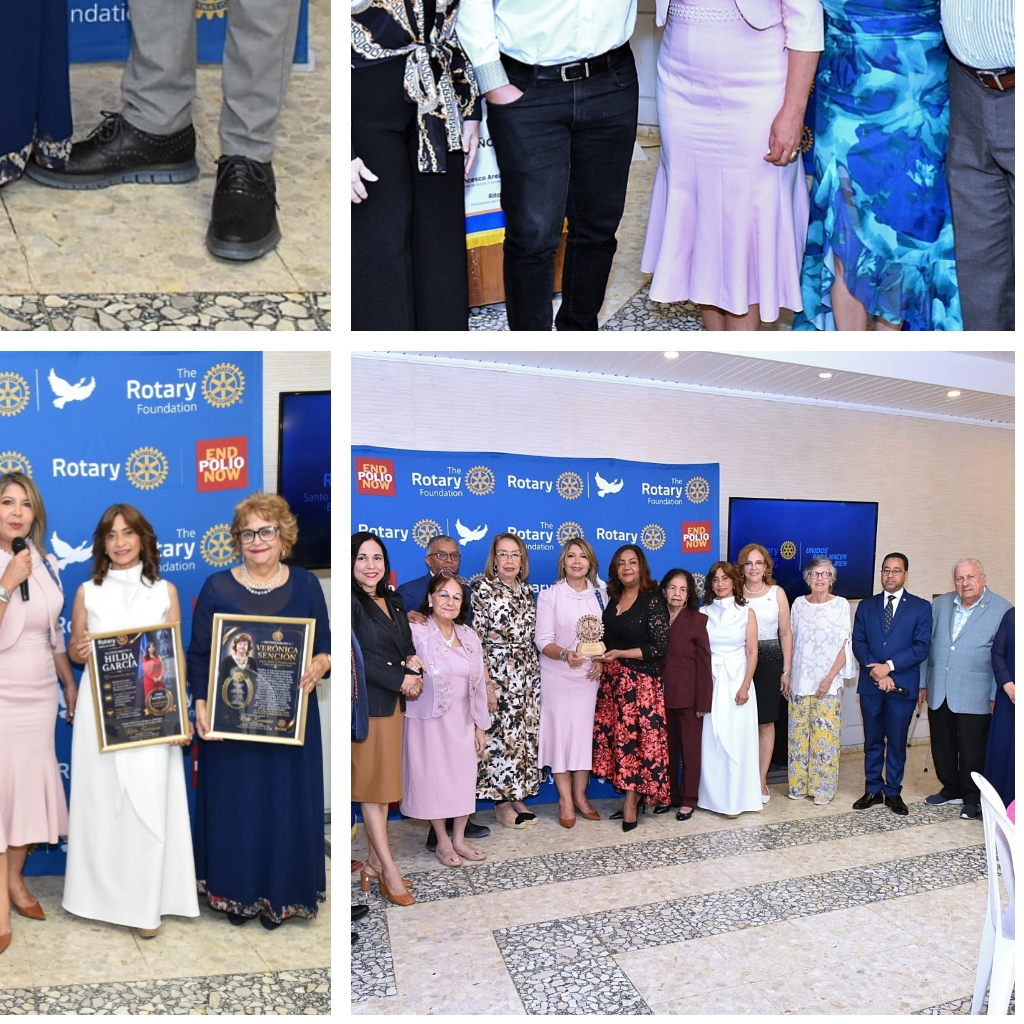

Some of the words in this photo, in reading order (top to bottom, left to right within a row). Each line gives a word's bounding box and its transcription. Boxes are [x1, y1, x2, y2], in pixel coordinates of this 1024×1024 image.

[177, 368, 196, 379] The
[127, 380, 196, 401] Rotary
[137, 403, 197, 414] Foundation
[206, 446, 238, 460] END
[52, 458, 120, 481] Rotary
[199, 456, 245, 472] POLIO
[362, 463, 387, 474] END
[204, 468, 240, 483] NOW
[358, 471, 392, 483] POLIO
[411, 472, 461, 489] Rotary
[362, 480, 391, 490] NOW
[507, 475, 553, 493] Rotary
[419, 489, 463, 497] Foundation
[641, 483, 683, 498] Rotary
[647, 497, 683, 505] Foundation
[540, 521, 553, 529] The
[687, 526, 706, 535] END
[176, 528, 195, 538] The
[596, 527, 638, 544] Rotary
[683, 533, 709, 542] POLIO
[686, 540, 707, 548] NOW
[104, 652, 134, 663] HILDA
[102, 657, 138, 672] GARCÍA
